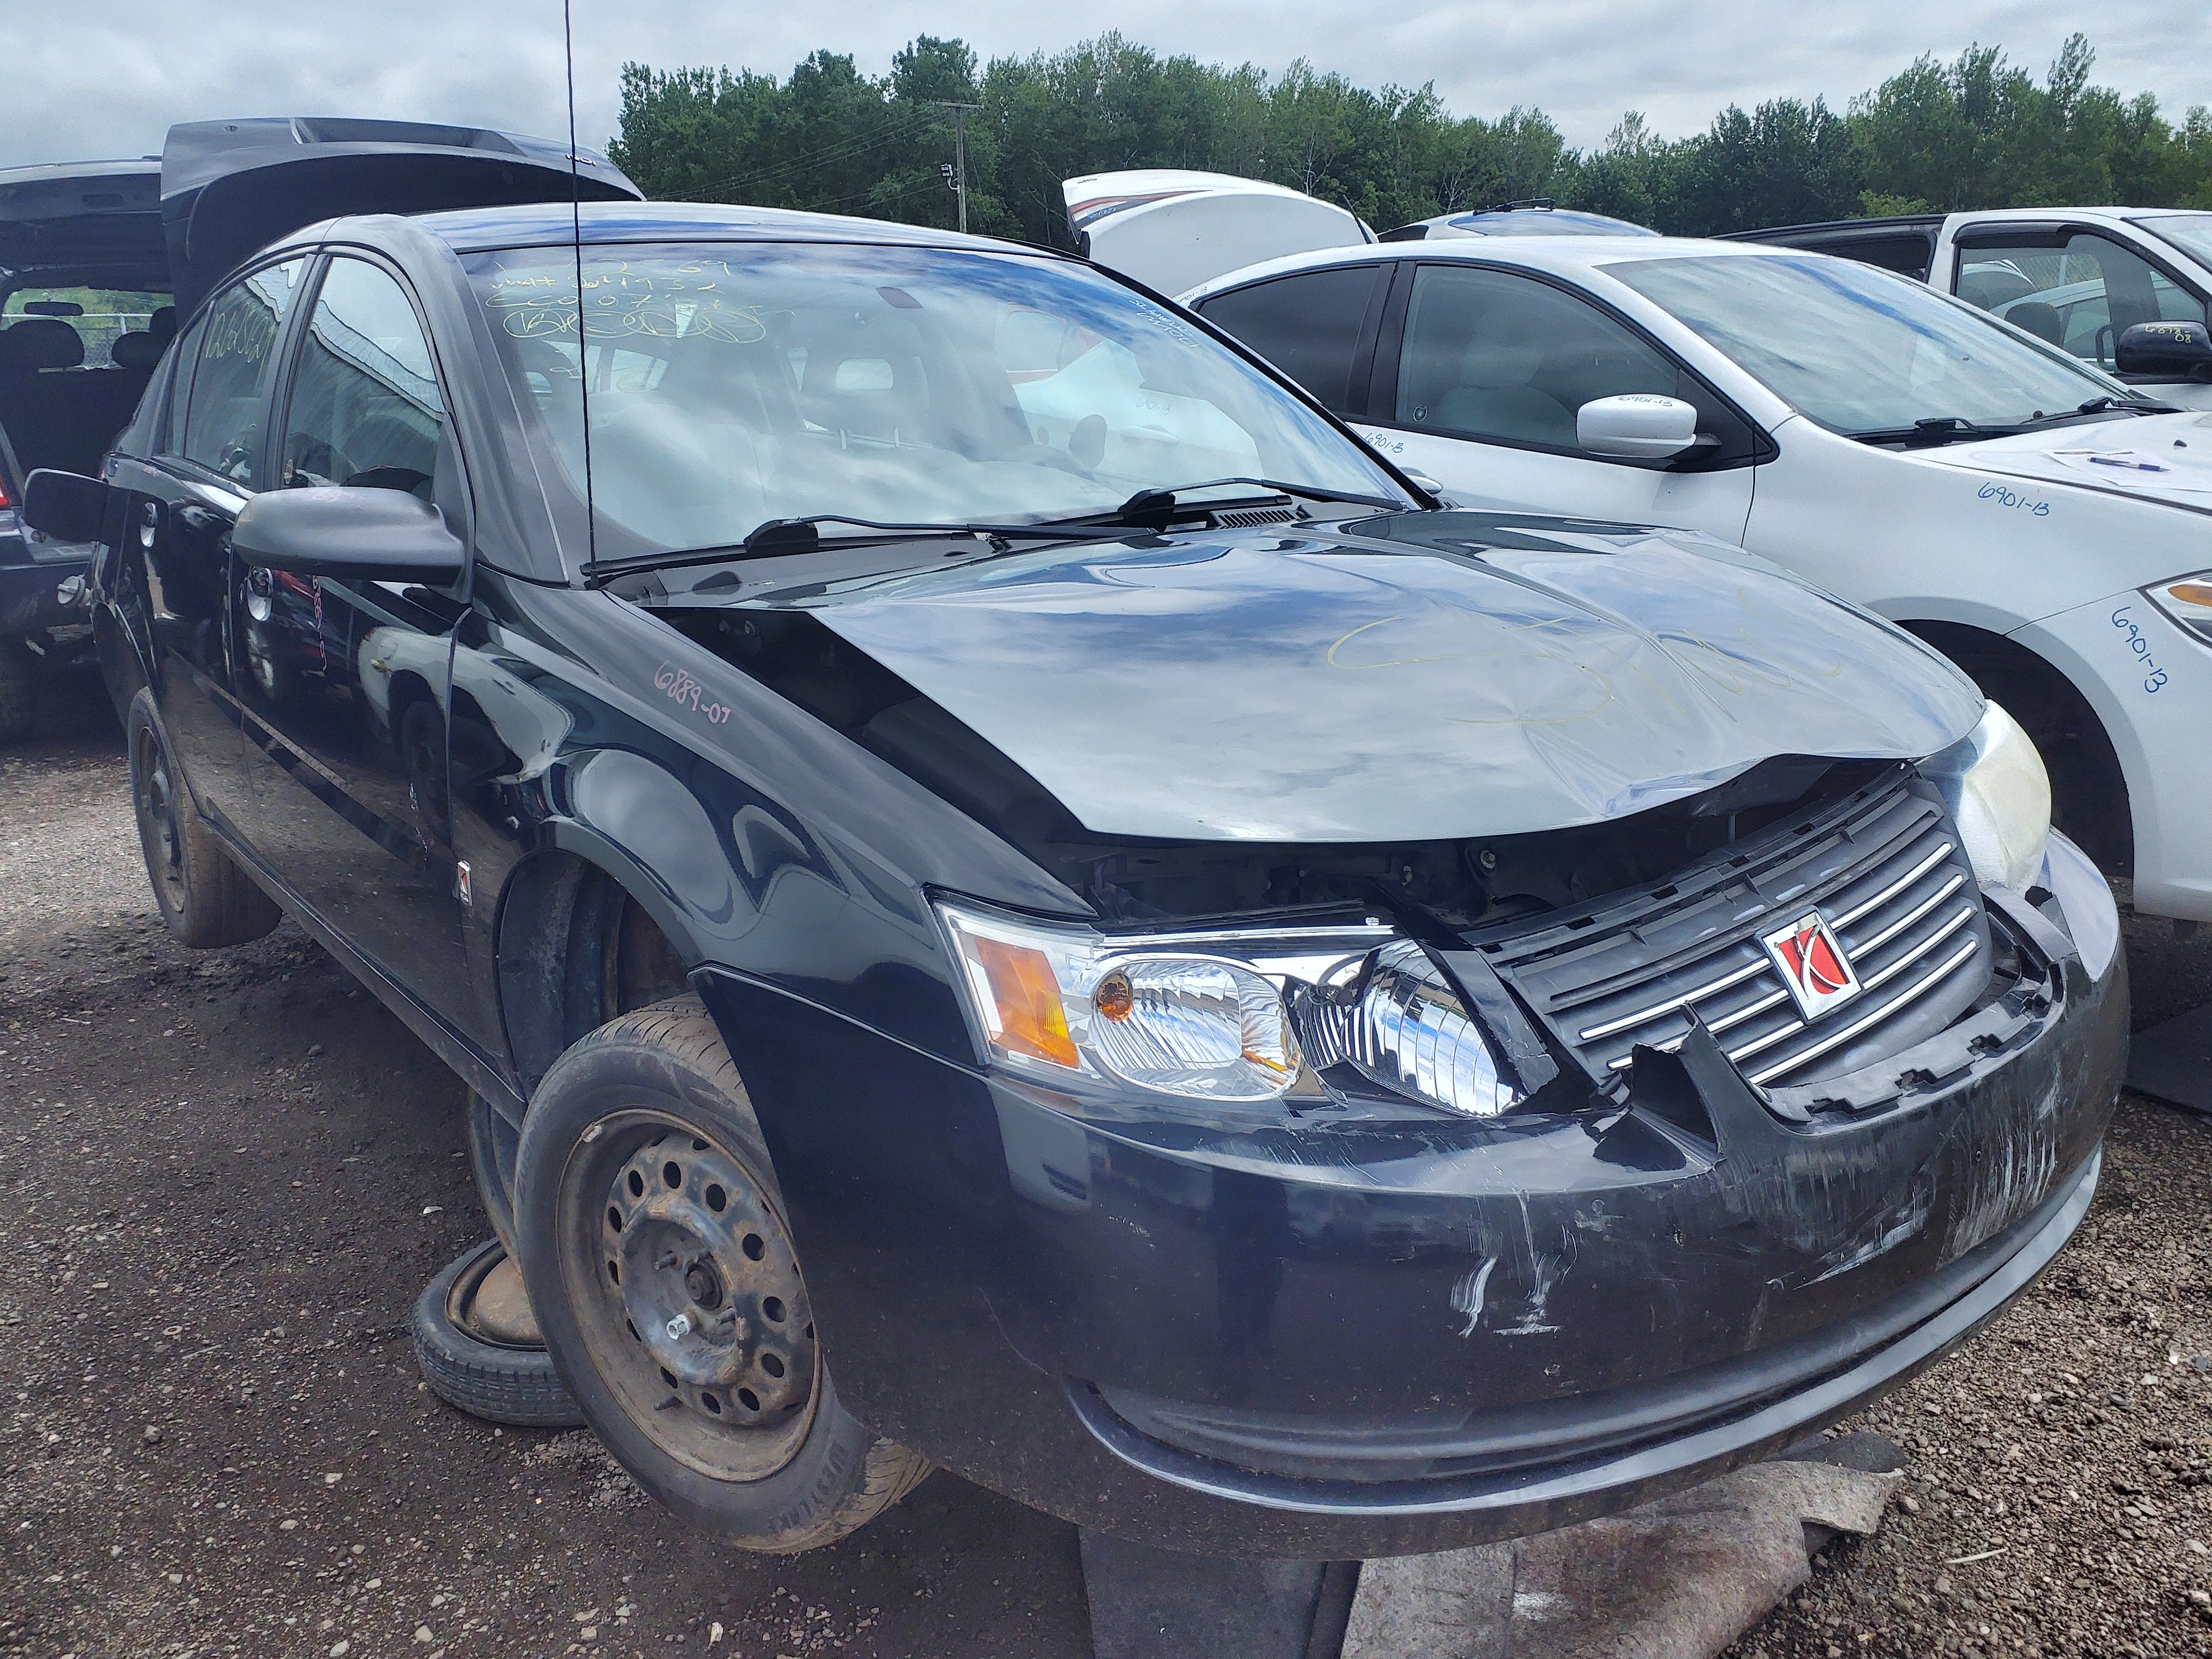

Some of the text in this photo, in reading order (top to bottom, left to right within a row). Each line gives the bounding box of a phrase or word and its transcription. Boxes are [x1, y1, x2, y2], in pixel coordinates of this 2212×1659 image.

[1618, 395, 1673, 407] 6901-13
[1977, 482, 2050, 517] 6901-13
[2111, 606, 2169, 693] 6901-13
[653, 659, 732, 724] 6889-07
